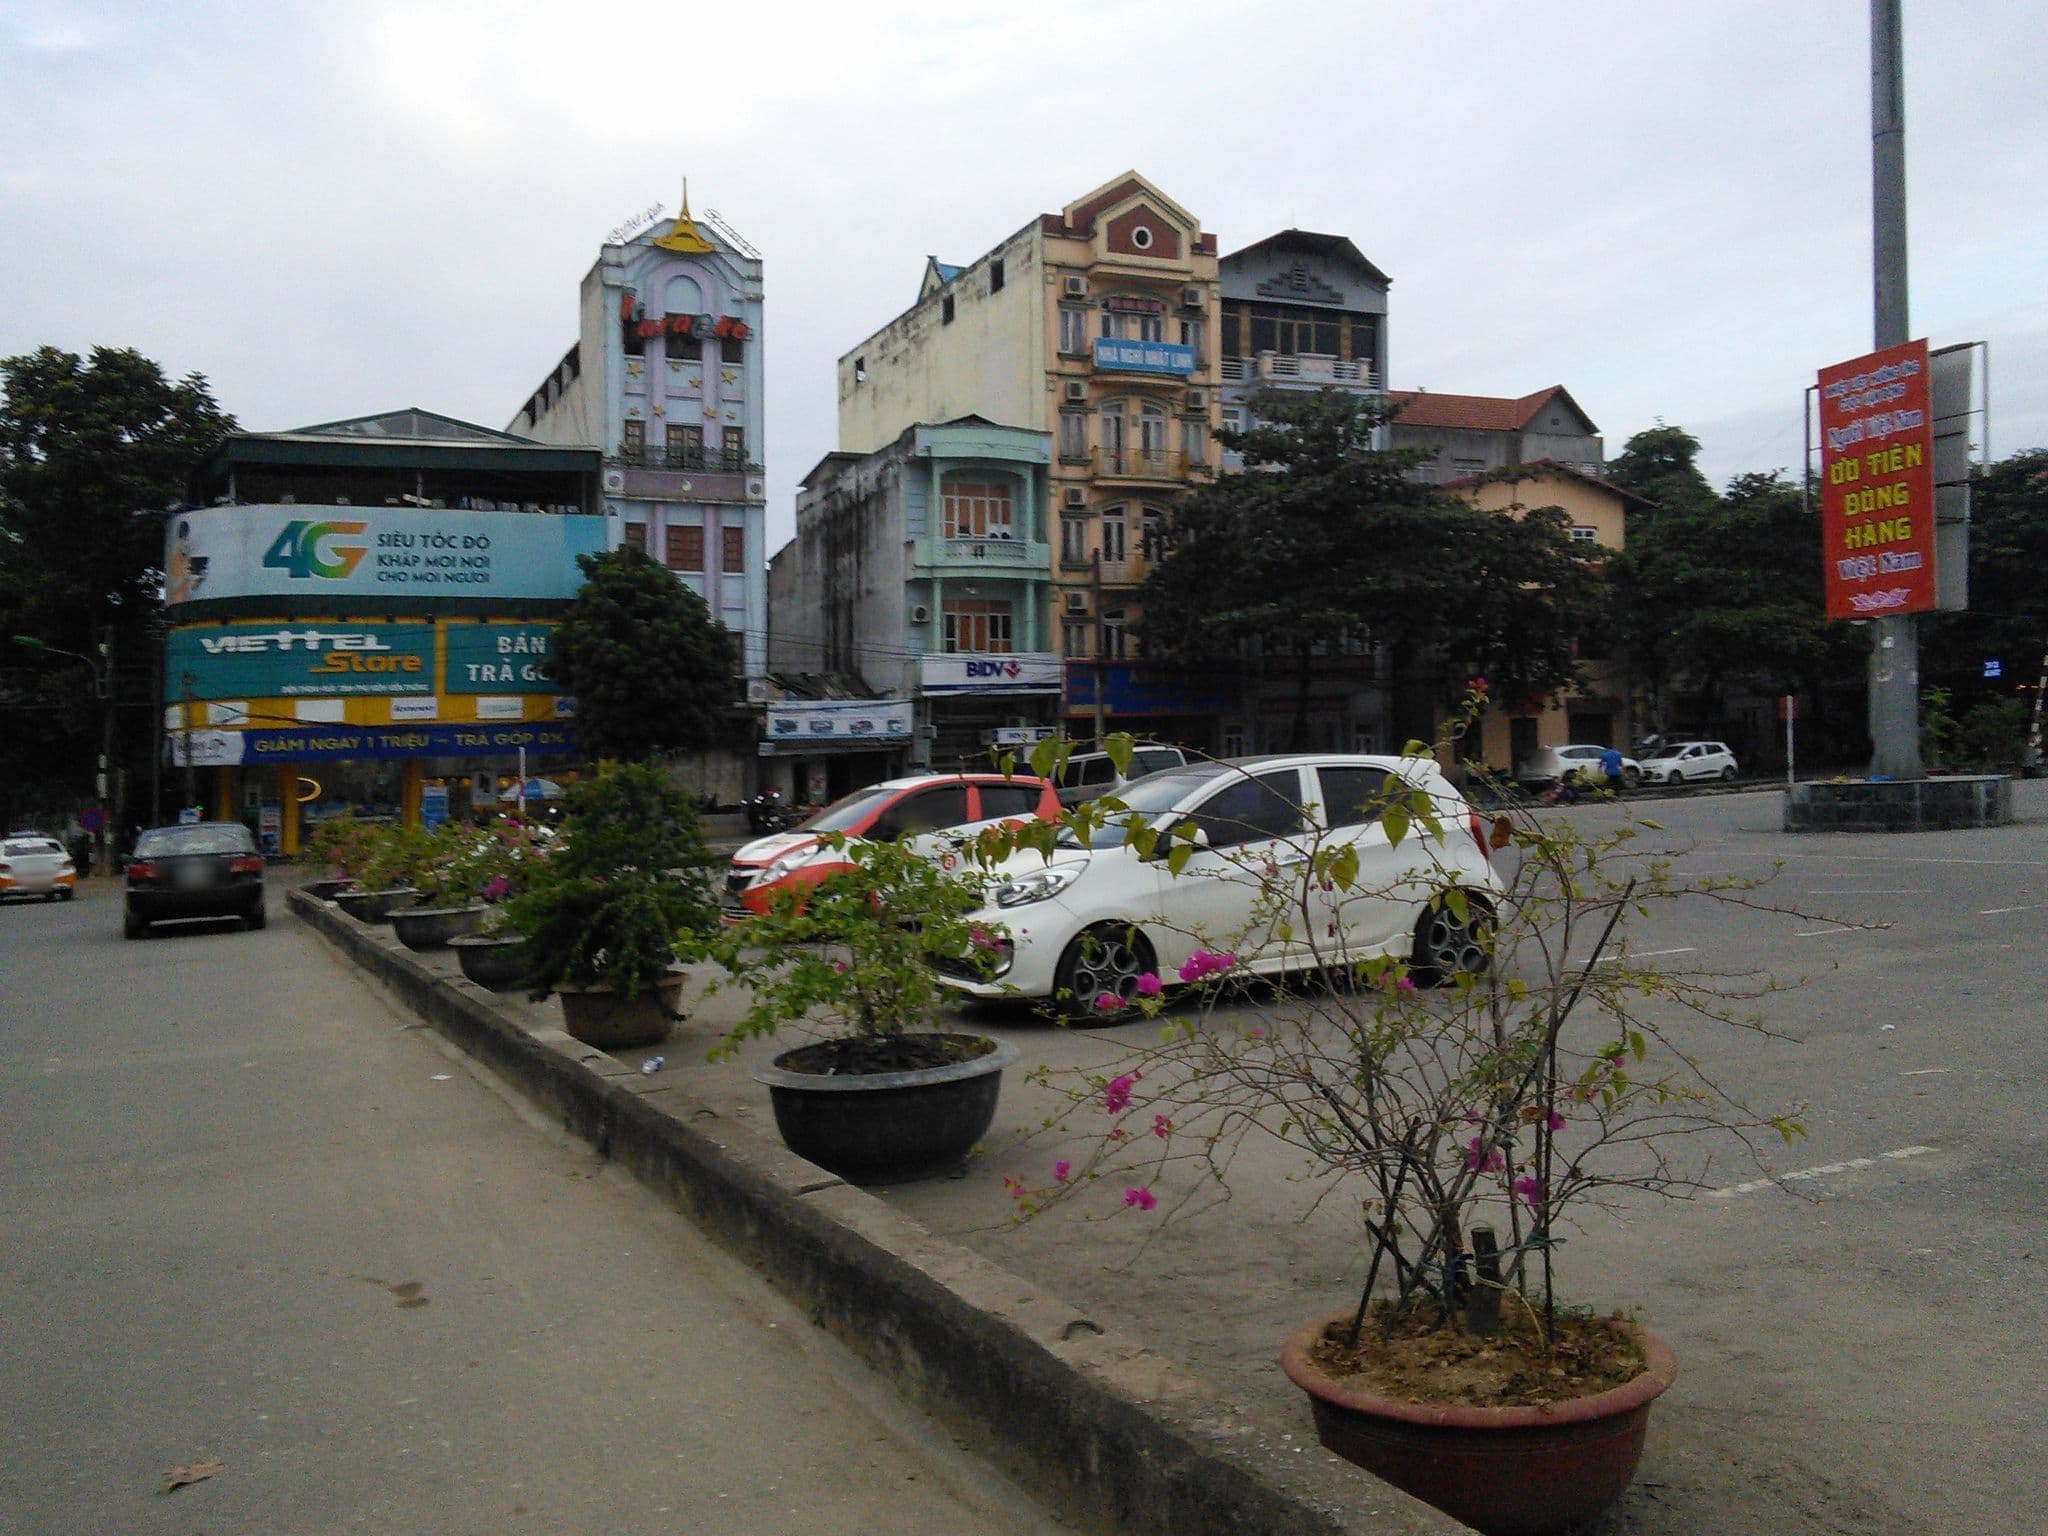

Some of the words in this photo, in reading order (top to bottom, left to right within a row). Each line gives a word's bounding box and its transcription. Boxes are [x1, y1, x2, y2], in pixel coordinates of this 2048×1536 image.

[1894, 409, 1923, 432] Nam
[1867, 442, 1923, 477] TIÊN
[376, 530, 415, 549] SIÊU
[419, 530, 458, 549] TỐC
[462, 532, 492, 551] ĐỘ
[1844, 517, 1913, 550] HÀNG
[262, 520, 369, 579] 4G
[1879, 551, 1924, 575] Nam
[377, 571, 407, 583] CHO
[496, 632, 547, 654] BÁN
[308, 651, 423, 673] Store
[465, 658, 516, 682] TRẢ
[966, 661, 1004, 677] BIDV
[254, 736, 305, 752] GIẢM
[309, 735, 361, 750] NGAY
[380, 732, 429, 750] TRIỆU
